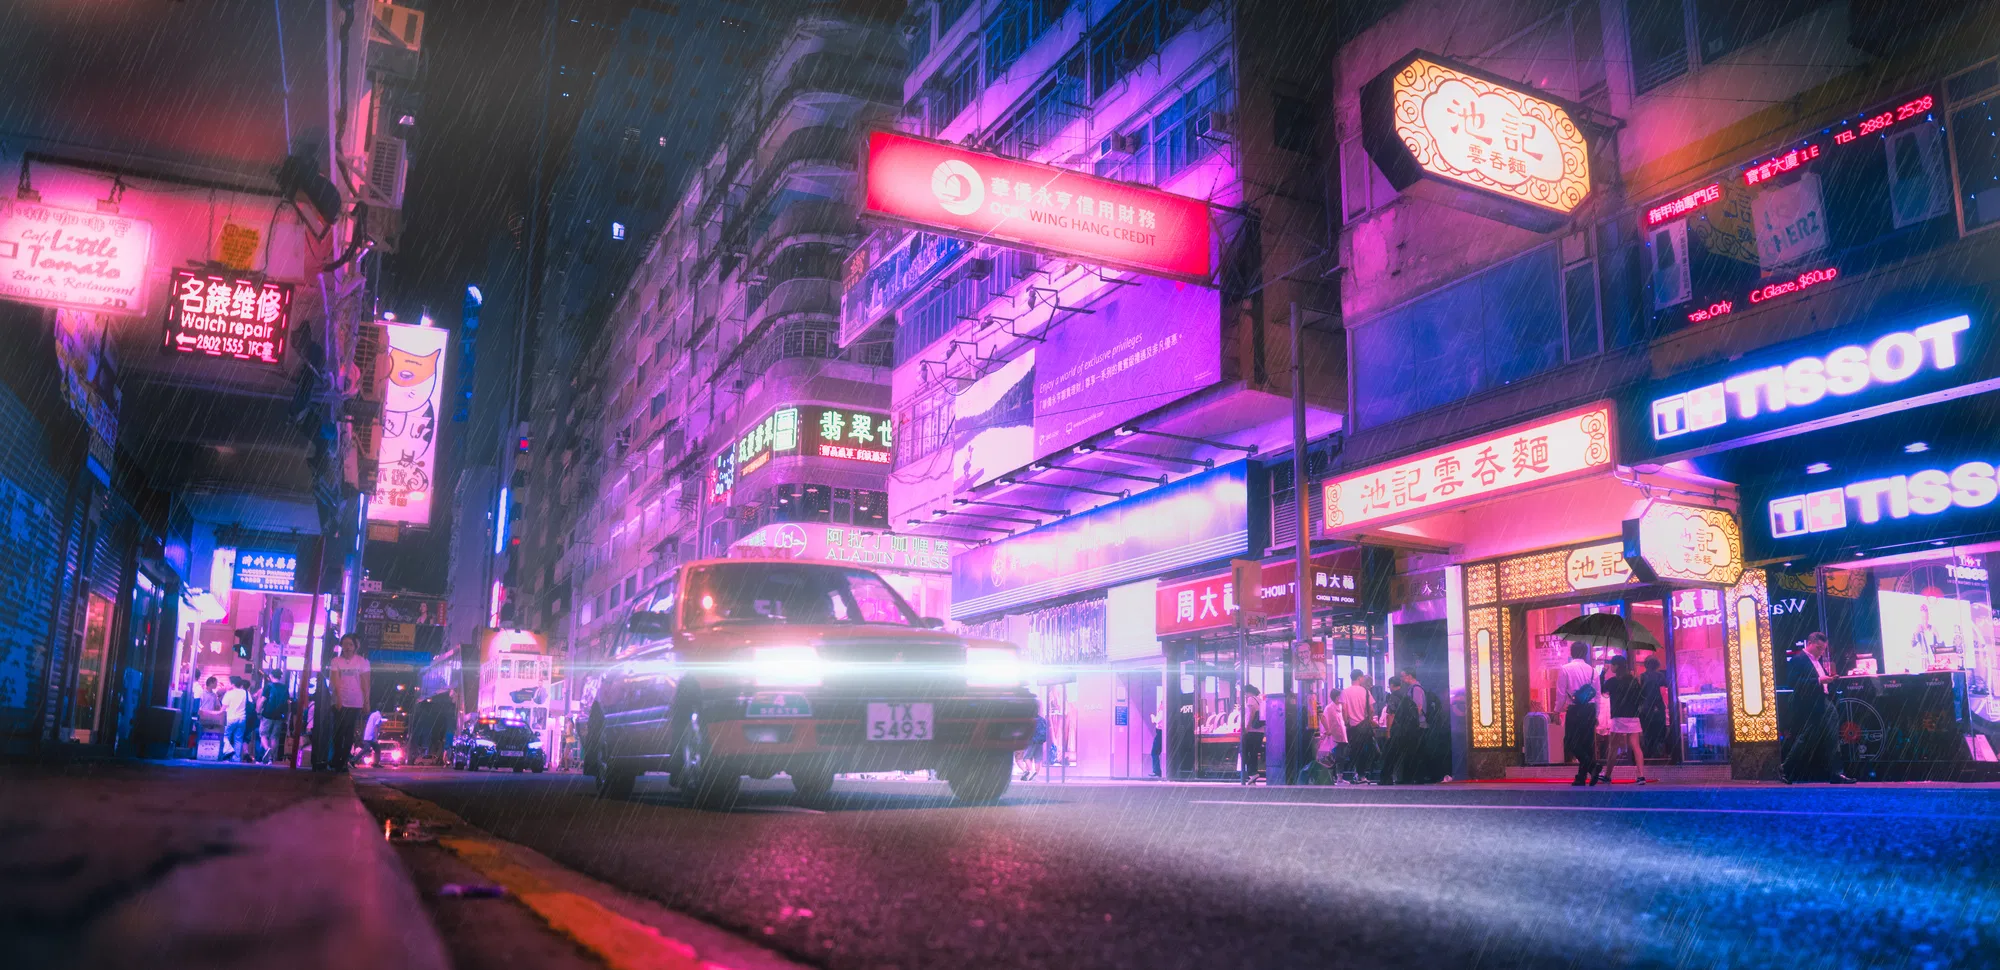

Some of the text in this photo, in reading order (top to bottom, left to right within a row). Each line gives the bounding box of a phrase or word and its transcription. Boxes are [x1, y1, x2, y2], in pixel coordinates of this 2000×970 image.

[1447, 99, 1543, 161] 池記
[1834, 130, 1856, 145] TEL
[1859, 112, 1893, 136] 2882
[1897, 95, 1932, 121] 2528
[1467, 143, 1528, 179] 雲吞麵
[991, 177, 1156, 229] 華僑永亨信用財務
[1649, 184, 1720, 224] 指甲油專門店
[1029, 209, 1067, 228] WING
[1071, 218, 1109, 237] HANG
[1113, 227, 1156, 246] CREDIT
[21, 228, 117, 258] Cafe Little
[28, 244, 121, 279] Tomato
[12, 269, 136, 297] Bar & Restaurant
[101, 296, 127, 309] 2D
[181, 311, 273, 339] Watch repair
[197, 334, 221, 352] 2802
[222, 336, 244, 353] 1555
[1039, 380, 1054, 394] Enjoy
[1060, 368, 1076, 382] world
[1084, 349, 1111, 370] exclusive
[1111, 333, 1143, 359] privileges
[1725, 315, 1970, 418] TISSOT
[1360, 435, 1549, 514] 池記雲吞麵
[1845, 461, 2000, 524] TISS
[825, 547, 950, 569] ALADIN MESS
[1572, 551, 1628, 580] 池記
[1261, 583, 1286, 599] CHOW
[1315, 572, 1354, 590] 周大福
[759, 706, 799, 715] SEATS
[888, 703, 913, 721] TX
[873, 720, 927, 739] 5493
